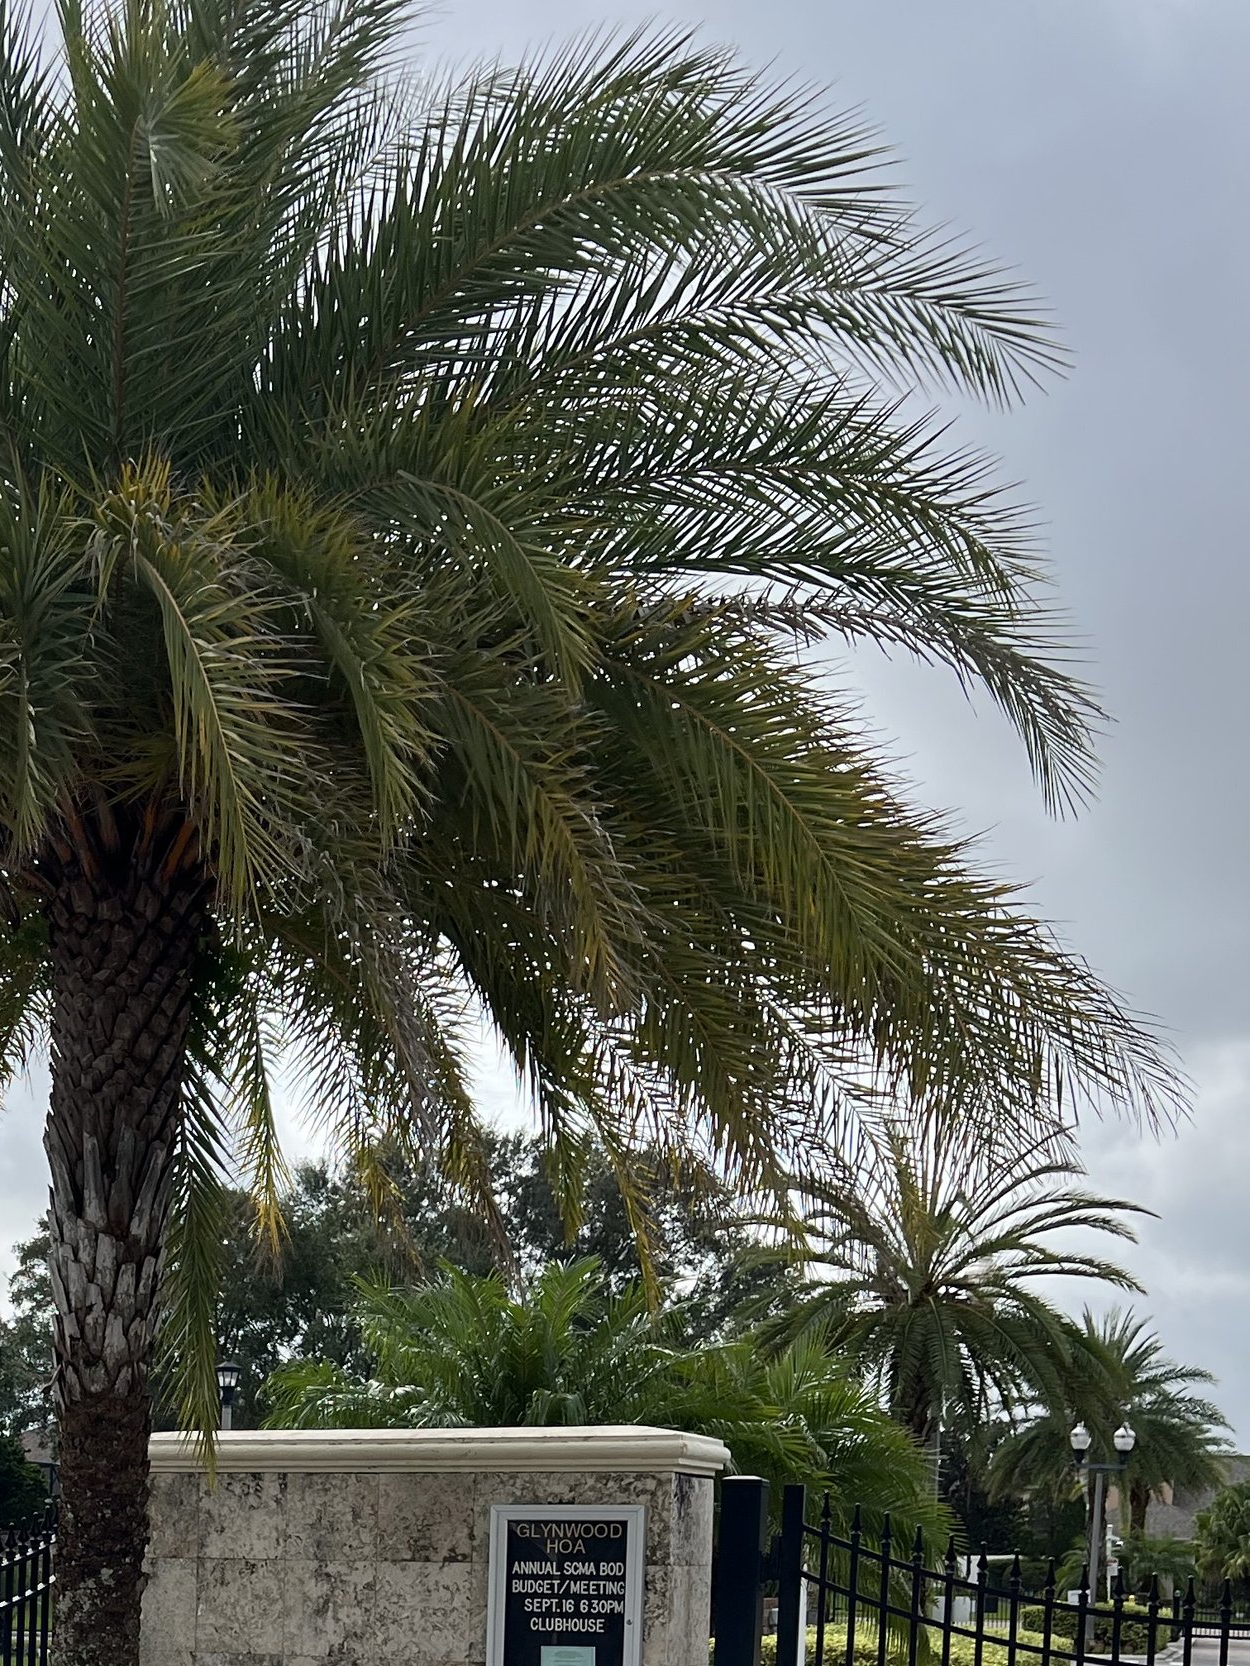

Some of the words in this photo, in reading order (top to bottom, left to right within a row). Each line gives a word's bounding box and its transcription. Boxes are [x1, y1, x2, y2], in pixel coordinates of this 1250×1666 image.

[516, 1523, 623, 1538] GLYNWOOD
[546, 1539, 586, 1554] HOA
[512, 1561, 561, 1575] ANNUAL
[563, 1562, 596, 1575] SCMA
[599, 1562, 625, 1576] BOD
[512, 1579, 625, 1595] BUDGET/MEETING
[530, 1617, 605, 1633] CLUBHOUSE
